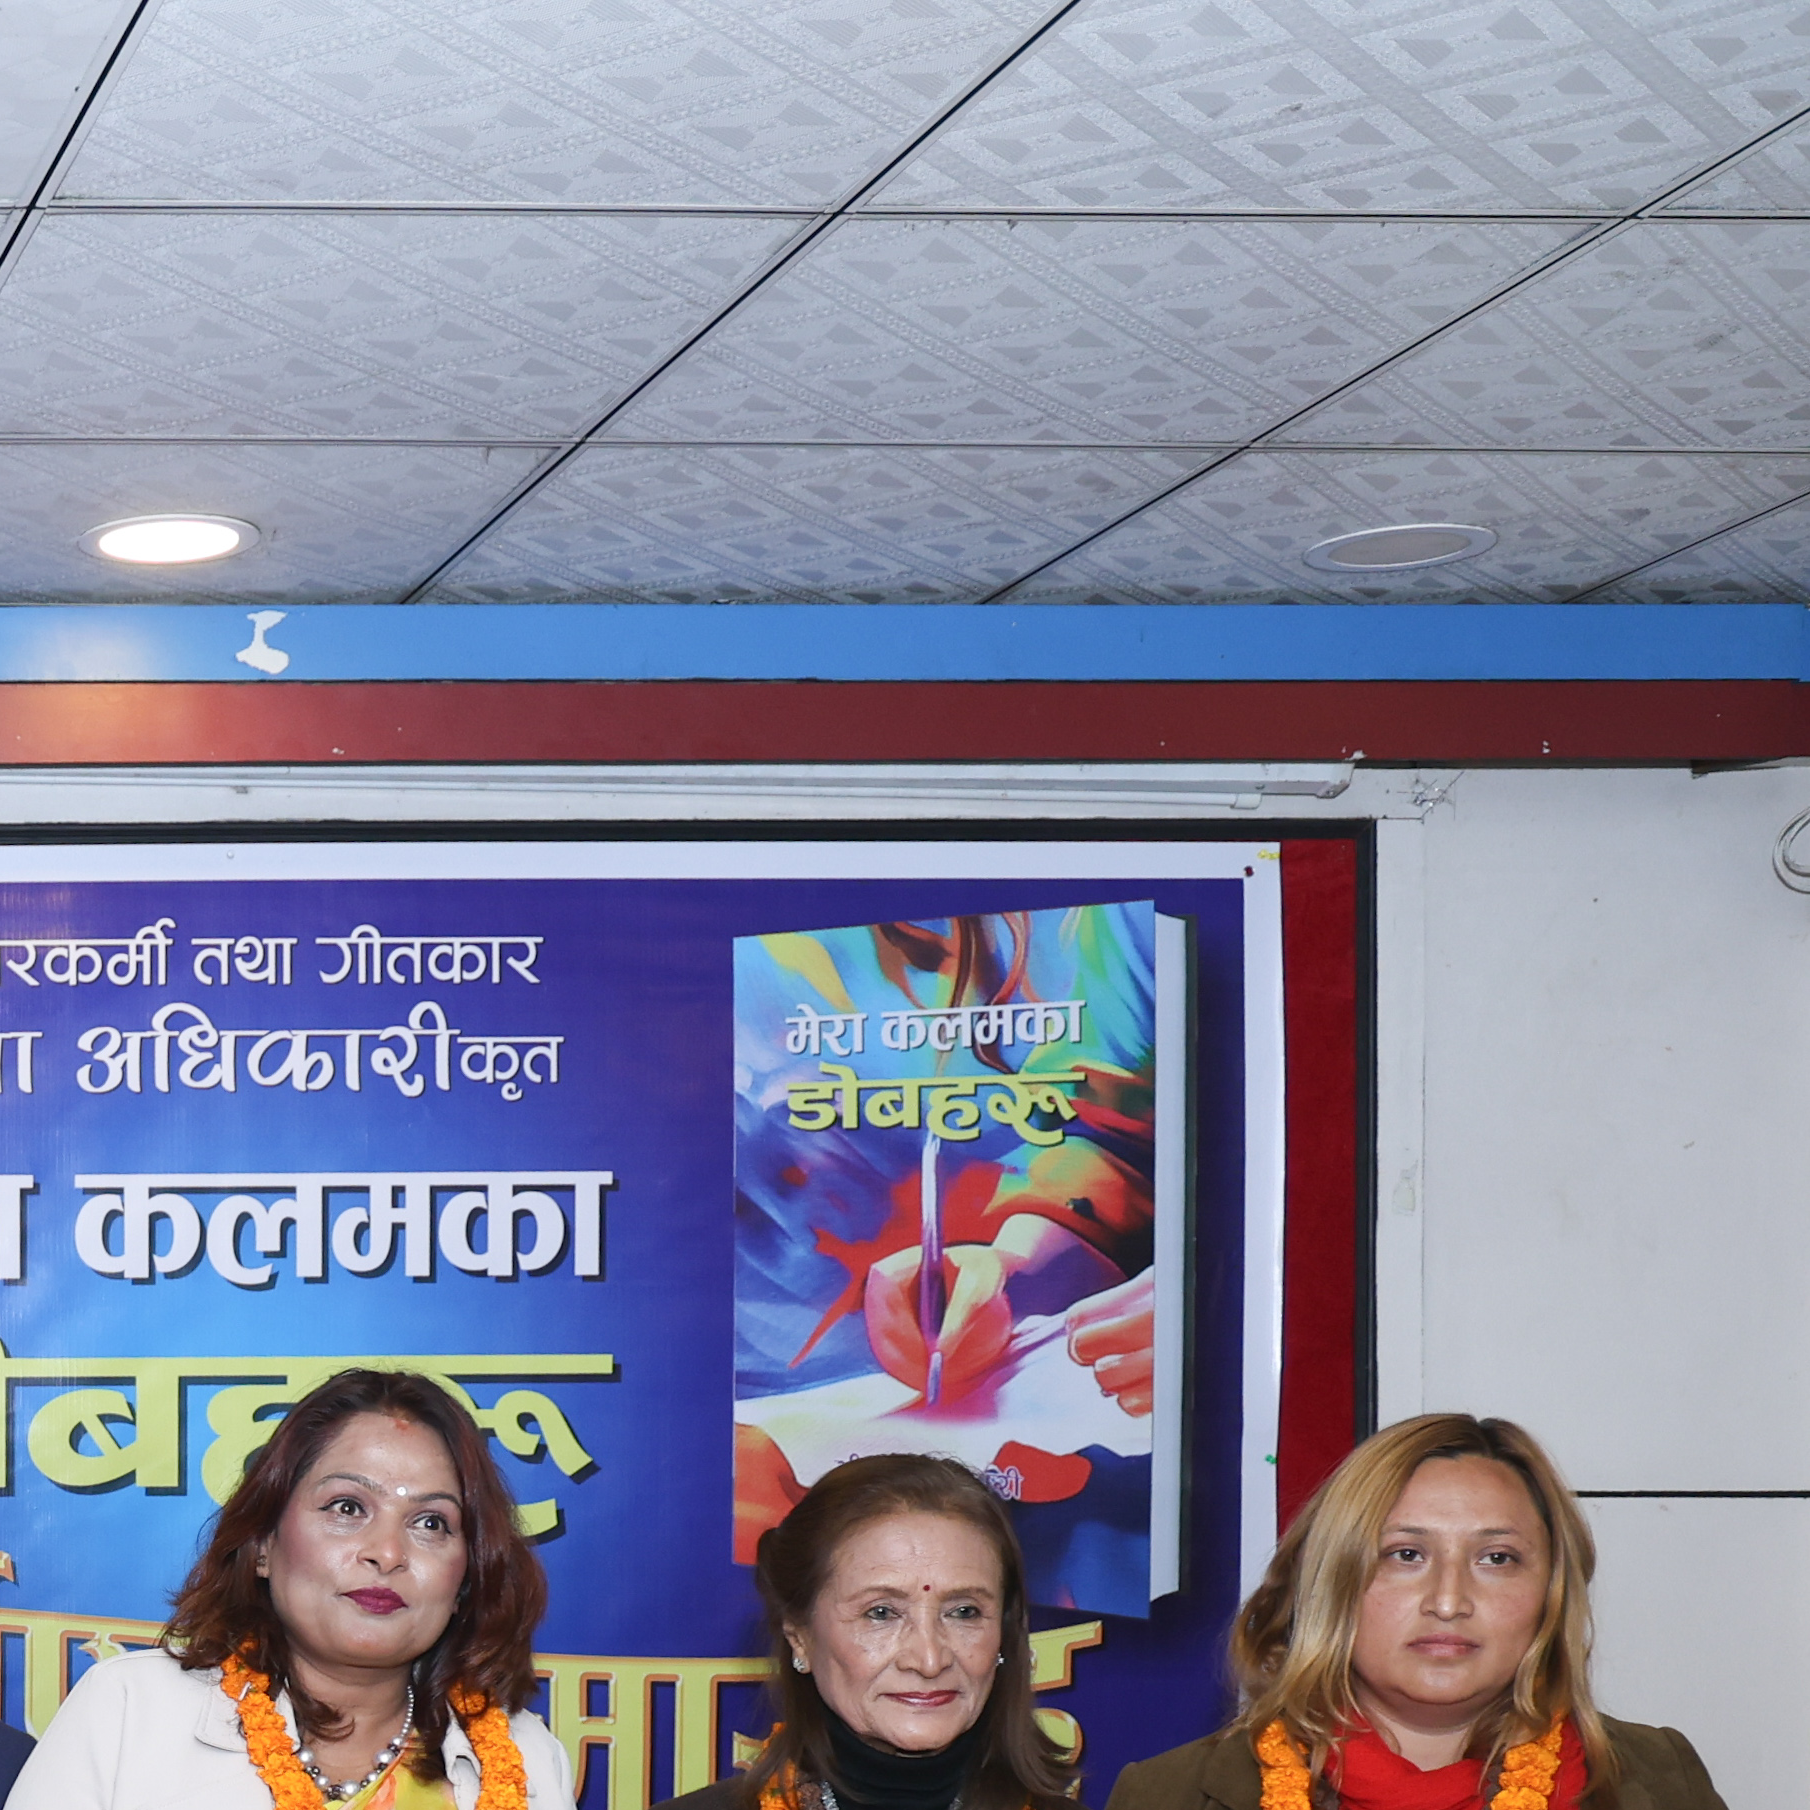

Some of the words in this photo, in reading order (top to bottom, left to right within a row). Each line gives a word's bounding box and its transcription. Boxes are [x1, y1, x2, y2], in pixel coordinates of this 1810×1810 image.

[192, 936, 297, 986] तथा
[317, 924, 543, 985] गीतकार
[785, 1003, 868, 1057] मेरा
[881, 1000, 1086, 1053] कलमका
[786, 1062, 1086, 1147] डोबहरू
[73, 1170, 615, 1288] कलमका
